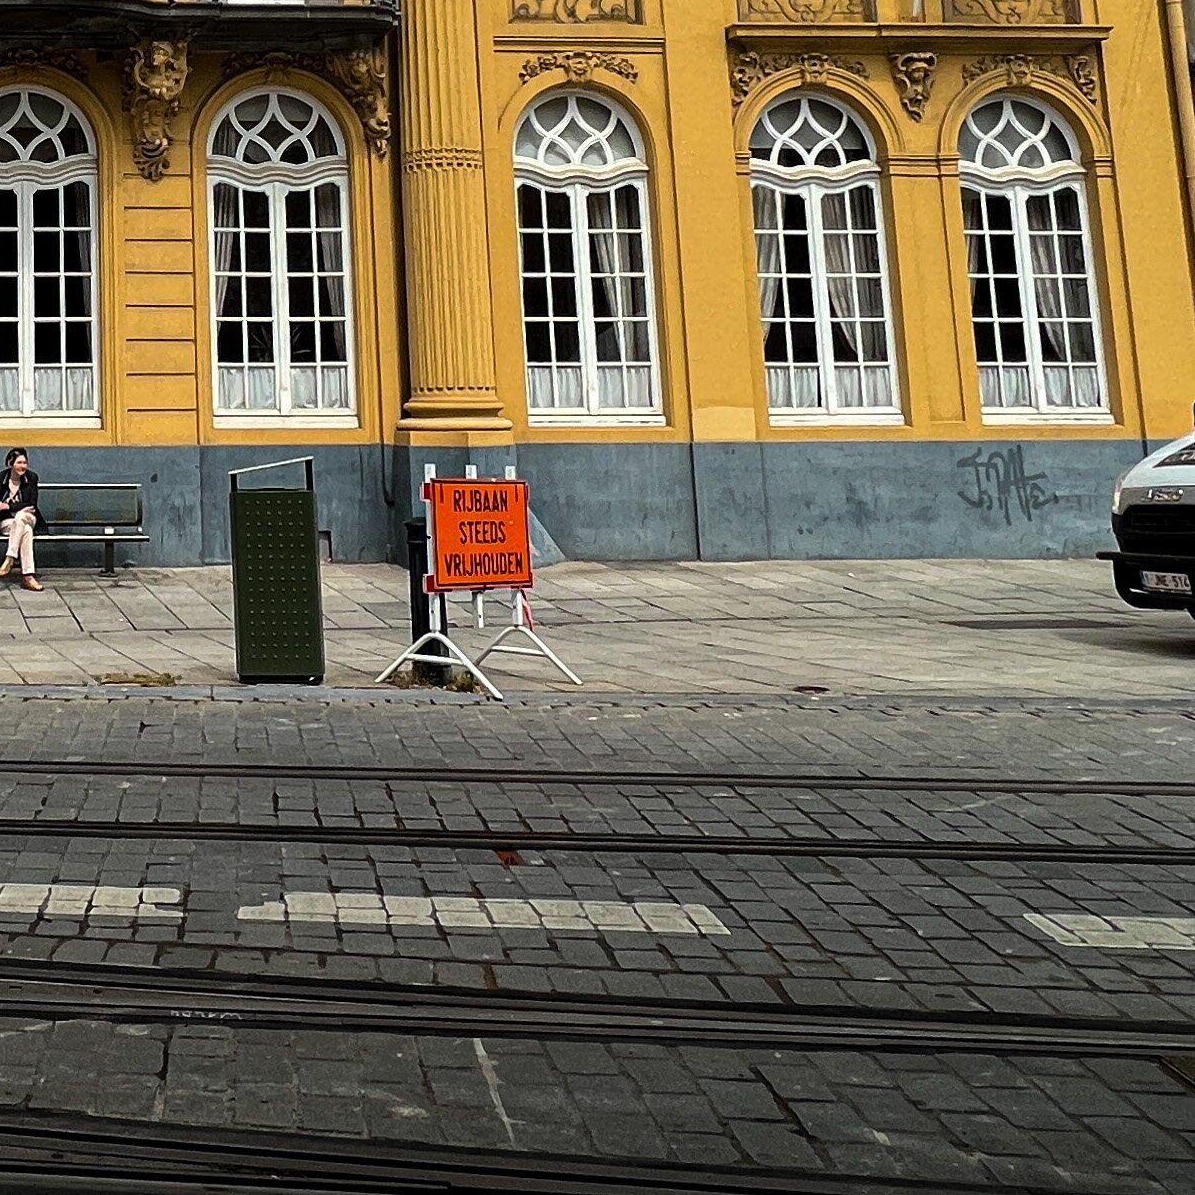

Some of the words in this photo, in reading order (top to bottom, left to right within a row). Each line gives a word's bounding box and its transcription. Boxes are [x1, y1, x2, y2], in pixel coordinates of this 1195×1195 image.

[453, 489, 509, 512] RIJBAAN
[458, 520, 506, 544] STEEDS
[444, 552, 523, 577] VRIJHOUDEN
